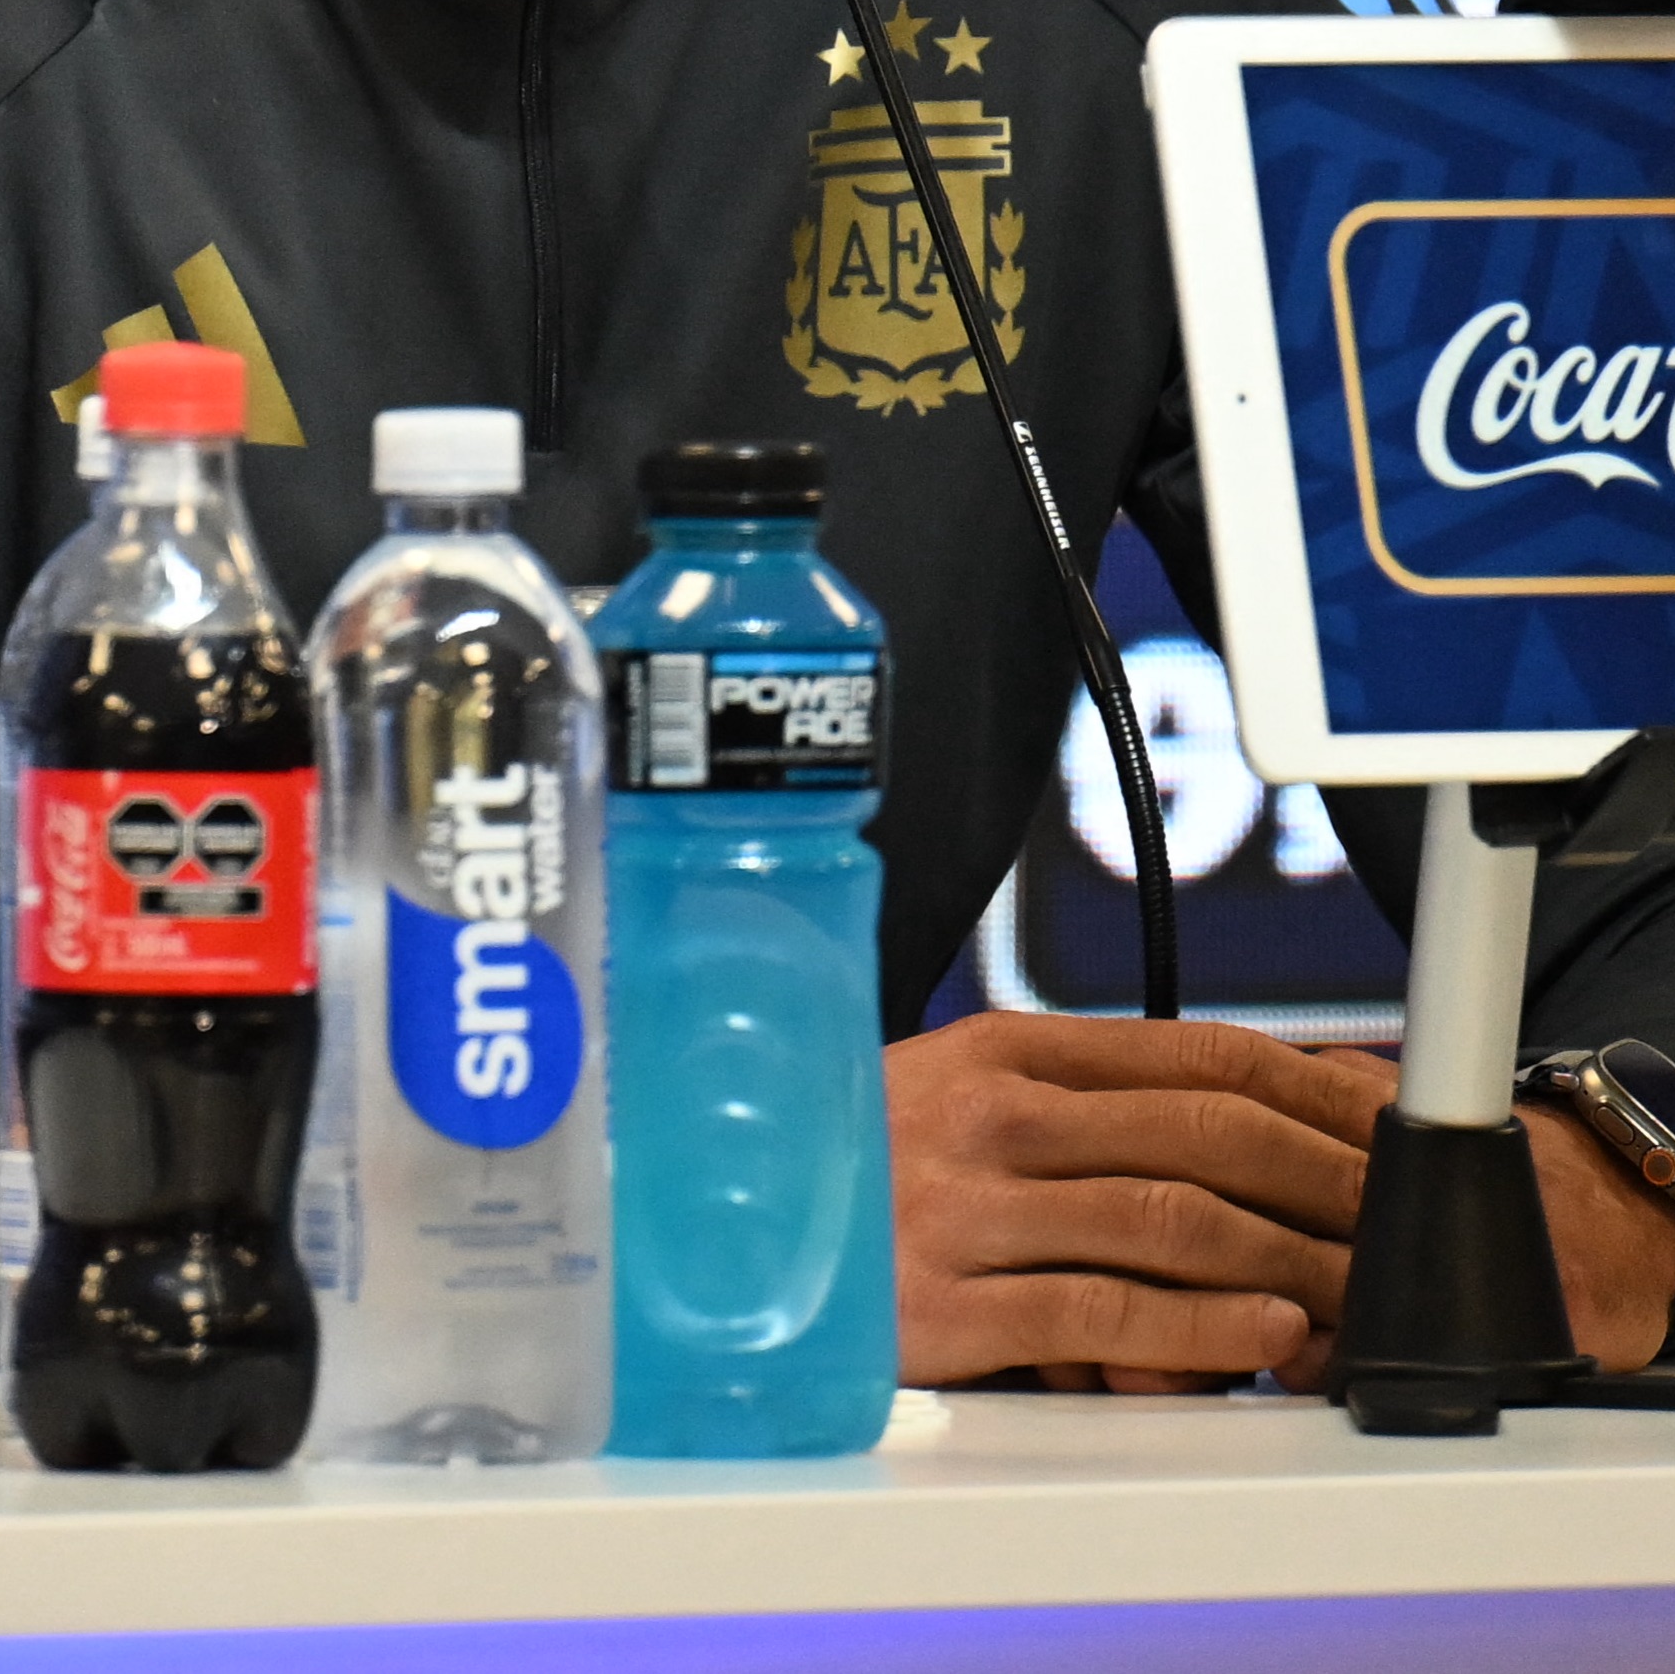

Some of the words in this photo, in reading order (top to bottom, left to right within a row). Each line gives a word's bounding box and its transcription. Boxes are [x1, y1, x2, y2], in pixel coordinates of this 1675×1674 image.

[1025, 445, 1071, 551] SENNHEISER
[711, 676, 875, 714] POWER
[532, 763, 565, 914] water
[435, 762, 532, 1099] smart
